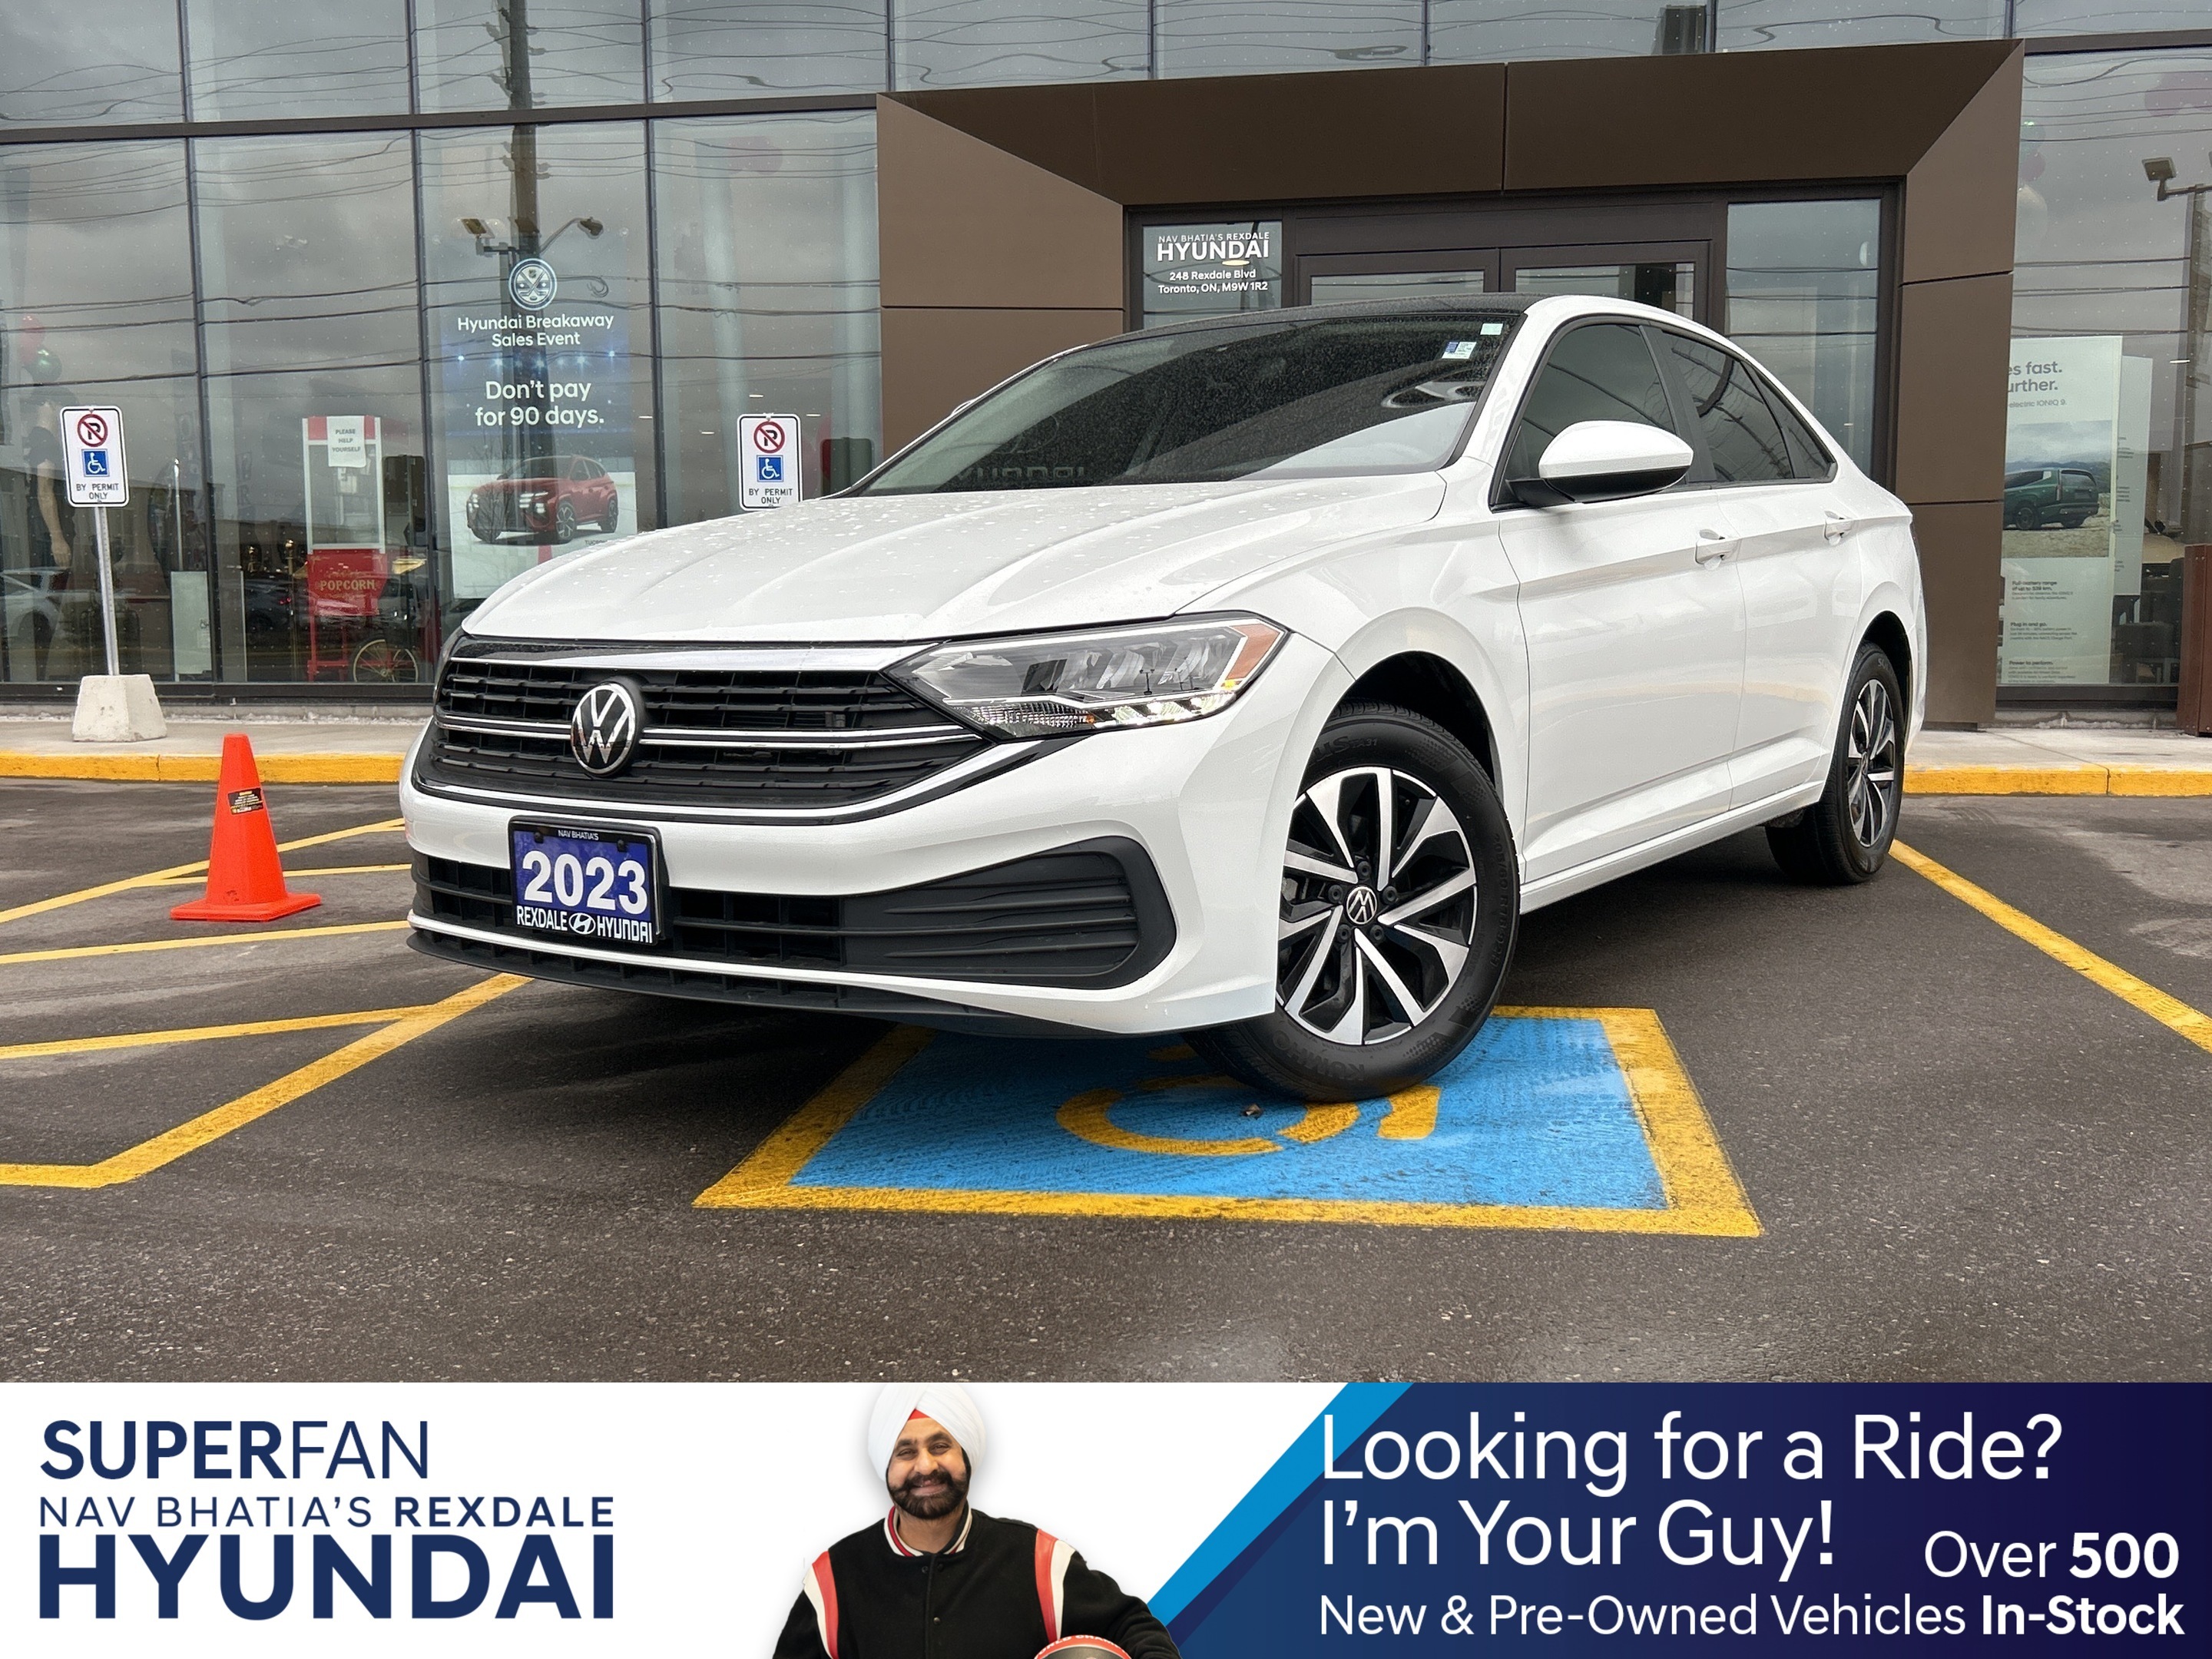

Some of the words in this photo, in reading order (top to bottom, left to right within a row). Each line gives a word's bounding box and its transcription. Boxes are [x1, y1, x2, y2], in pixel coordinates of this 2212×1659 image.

[1181, 233, 1224, 243] BHATIA'S
[1227, 232, 1270, 240] REXDALE
[1157, 240, 1269, 261] HYUNDAI
[1169, 271, 1189, 281] 248
[1191, 270, 1232, 280] Rexdale
[1233, 269, 1257, 279] Blvd
[1158, 284, 1200, 295] Toronto,
[1201, 283, 1220, 293] ON,
[1222, 282, 1248, 292] M9W
[1250, 281, 1268, 291] 1R2
[458, 315, 522, 333] Hyundai
[526, 313, 614, 329] Breakaway
[492, 333, 534, 346] Sales
[537, 332, 581, 346] Event
[2025, 361, 2063, 375] fast.
[485, 380, 545, 399] Don't
[550, 382, 592, 402] pay
[475, 406, 506, 426] for
[510, 406, 540, 426] 90
[545, 406, 605, 428] days.
[76, 483, 87, 492] BY
[92, 483, 119, 492] PERMIT
[88, 492, 108, 500] ONLY
[761, 496, 781, 505] ONLY
[320, 579, 376, 591] POPCORN
[558, 830, 572, 839] NAV
[571, 830, 599, 841] BHATIA'S
[522, 850, 648, 915] 2023
[516, 905, 568, 931] REXDALE
[597, 915, 653, 944] HYUNDAI
